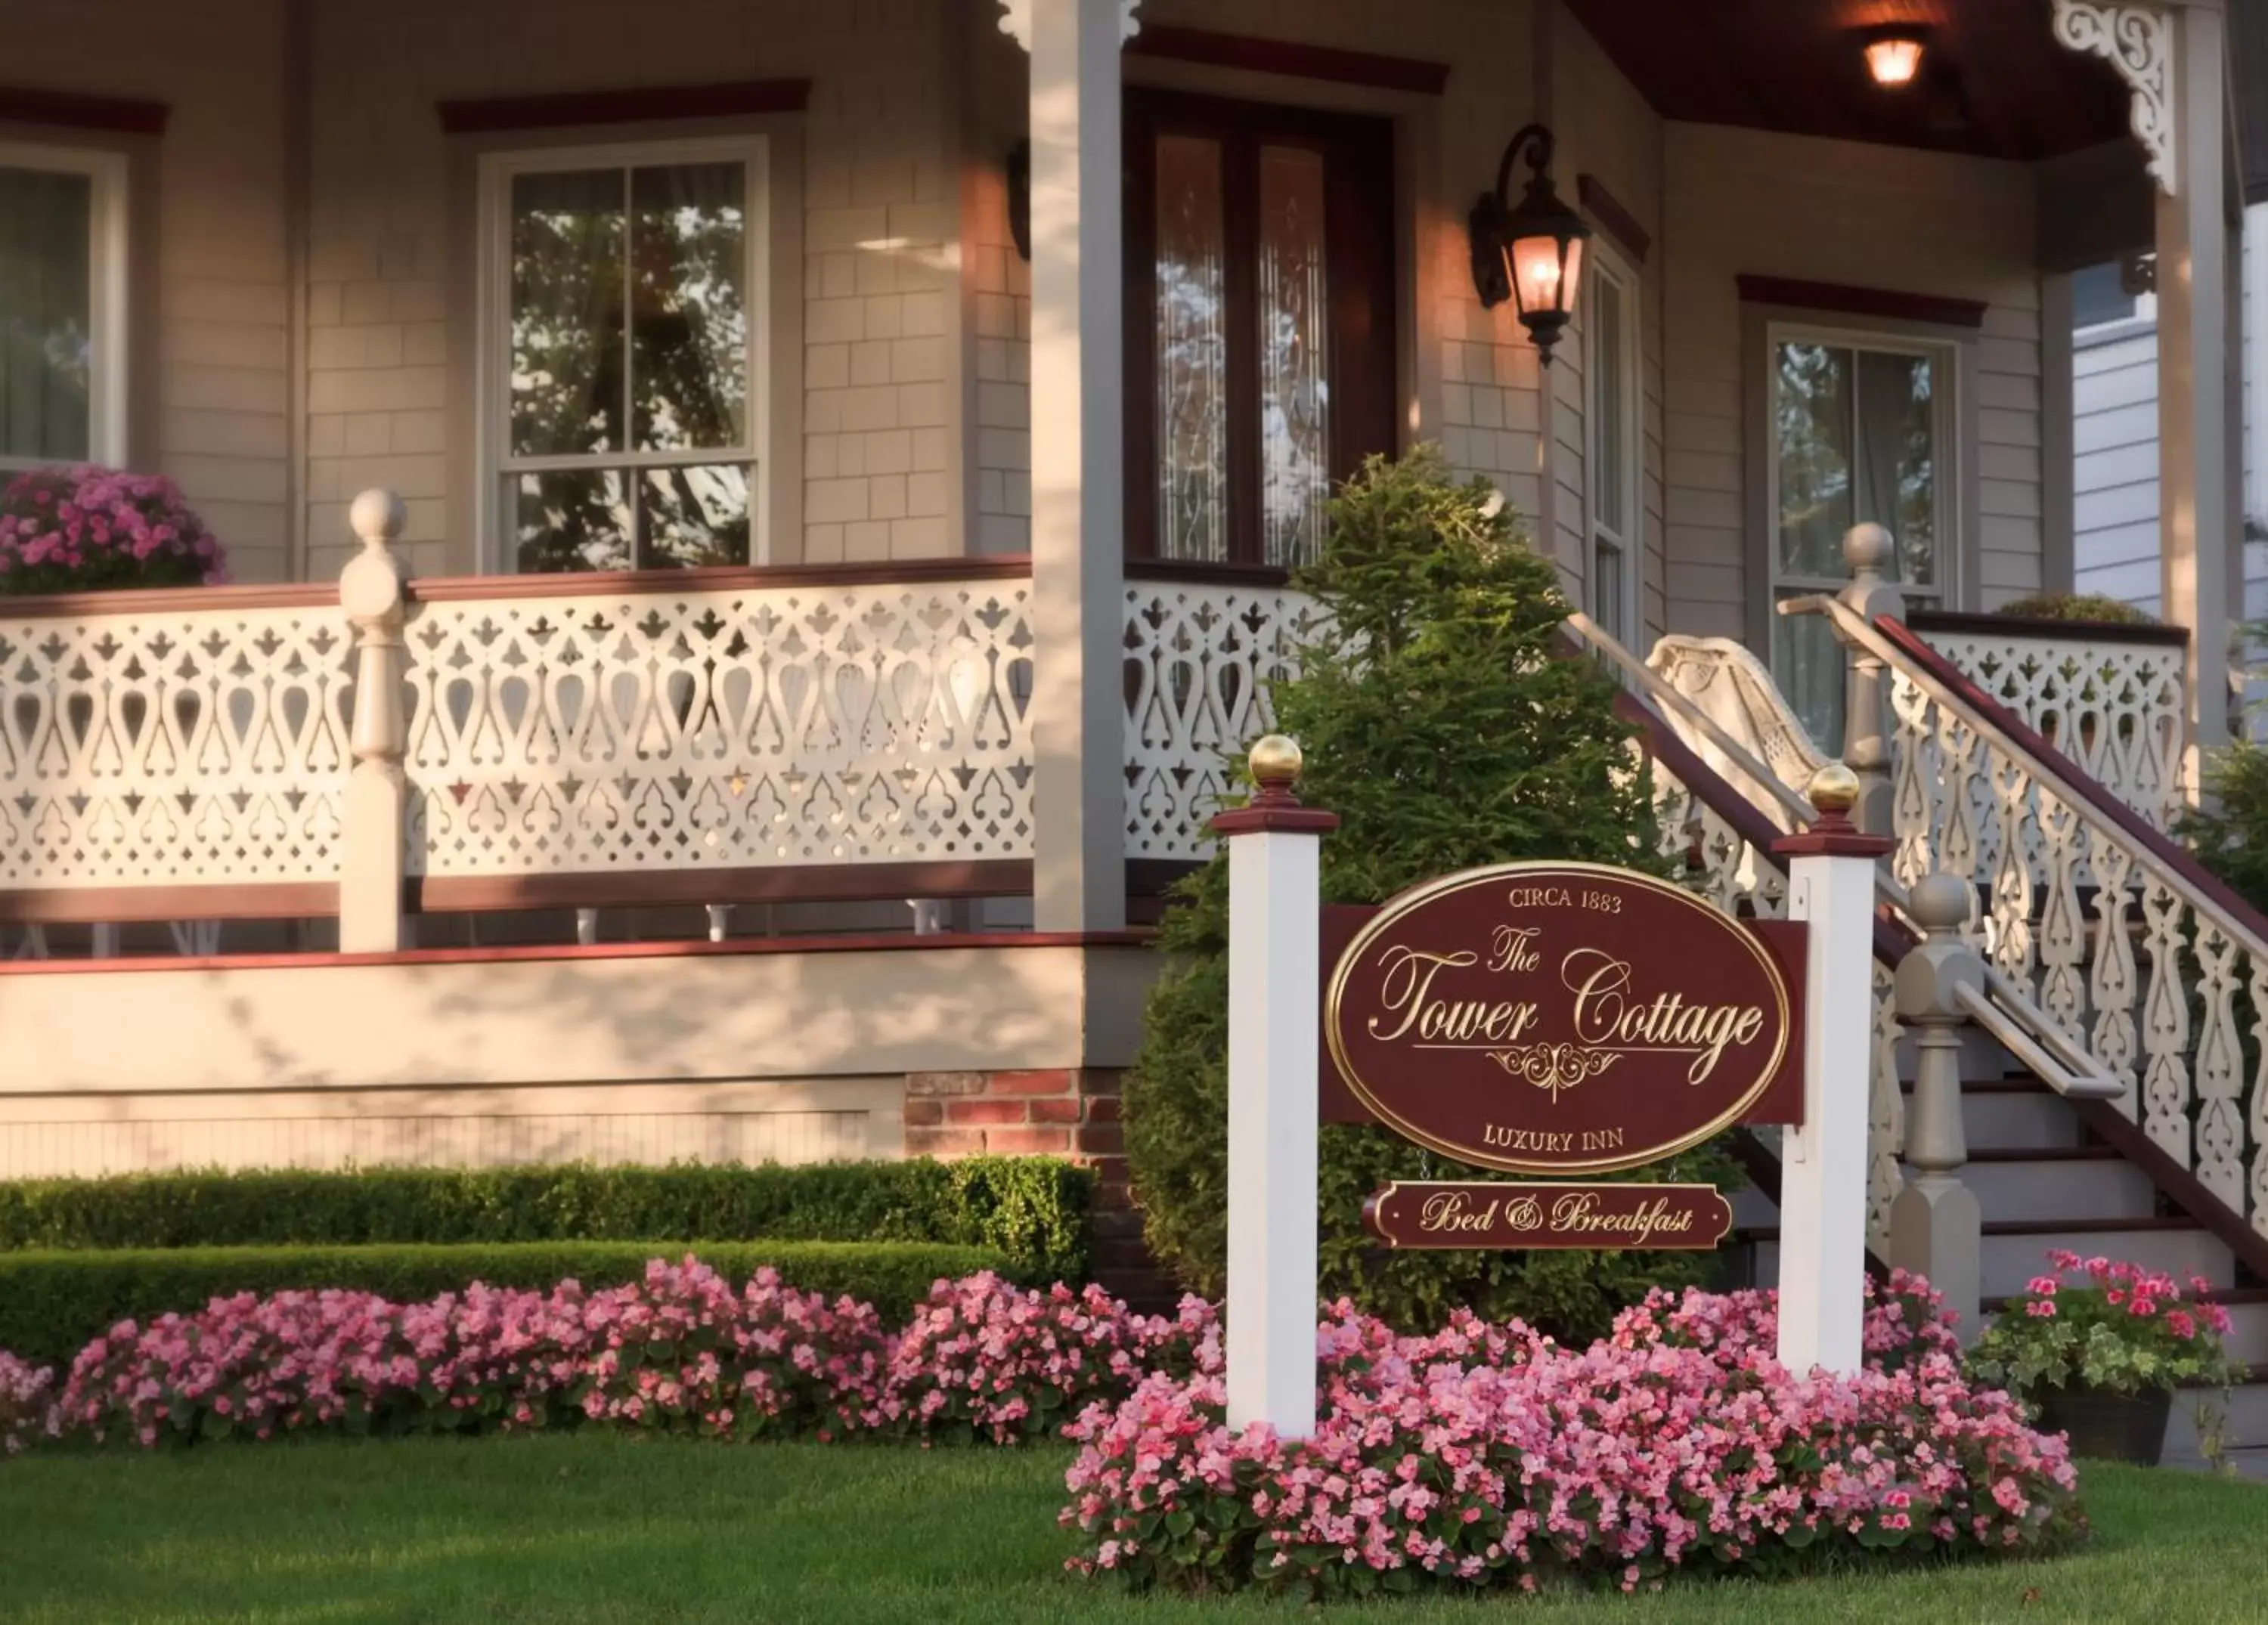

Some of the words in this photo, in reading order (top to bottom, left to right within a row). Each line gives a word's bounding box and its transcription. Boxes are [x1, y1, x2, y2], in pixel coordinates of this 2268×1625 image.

[1509, 888, 1572, 908] CIRCA
[1582, 890, 1622, 914] 1883
[1487, 924, 1541, 972] The
[1368, 945, 1539, 1041] Tower
[1560, 947, 1763, 1085] Cottage
[1483, 1123, 1574, 1152] LUXURY
[1582, 1127, 1624, 1150] INN
[1421, 1191, 1498, 1231] Bed
[1505, 1193, 1544, 1231] &
[1549, 1191, 1693, 1245] Breakfast
